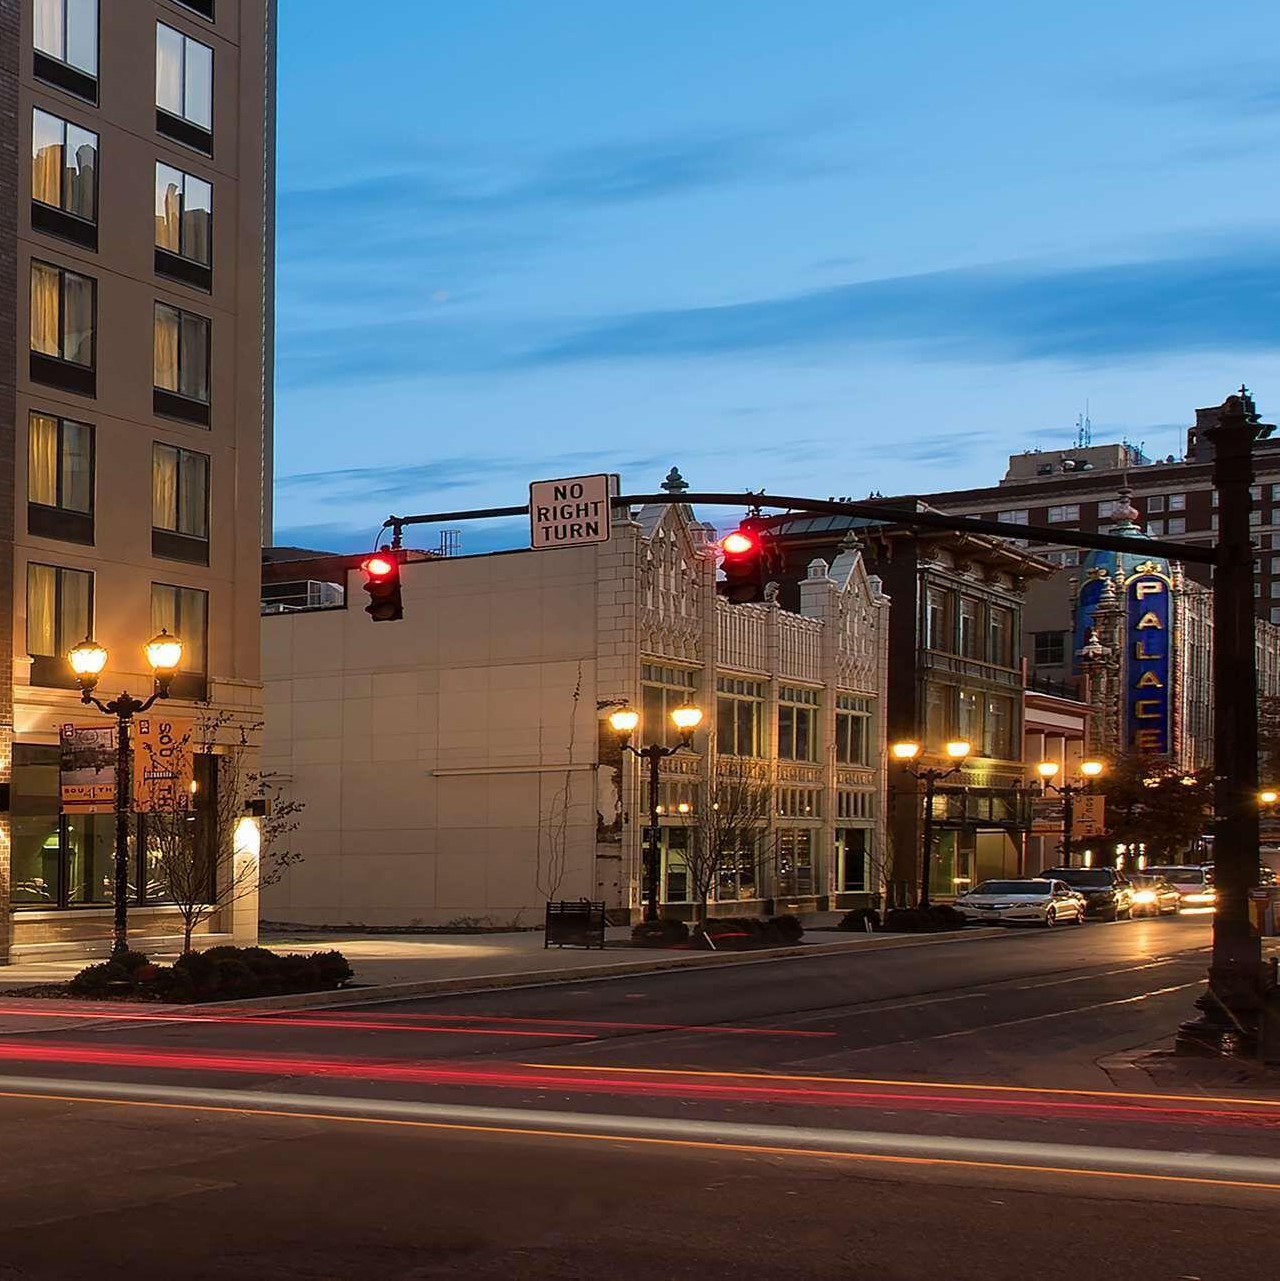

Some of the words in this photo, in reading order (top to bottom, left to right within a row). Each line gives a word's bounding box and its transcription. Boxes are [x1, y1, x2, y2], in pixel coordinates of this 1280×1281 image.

[553, 483, 584, 502] NO
[536, 500, 605, 523] RIGHT
[541, 521, 599, 542] TURN
[1135, 581, 1164, 749] PALACE
